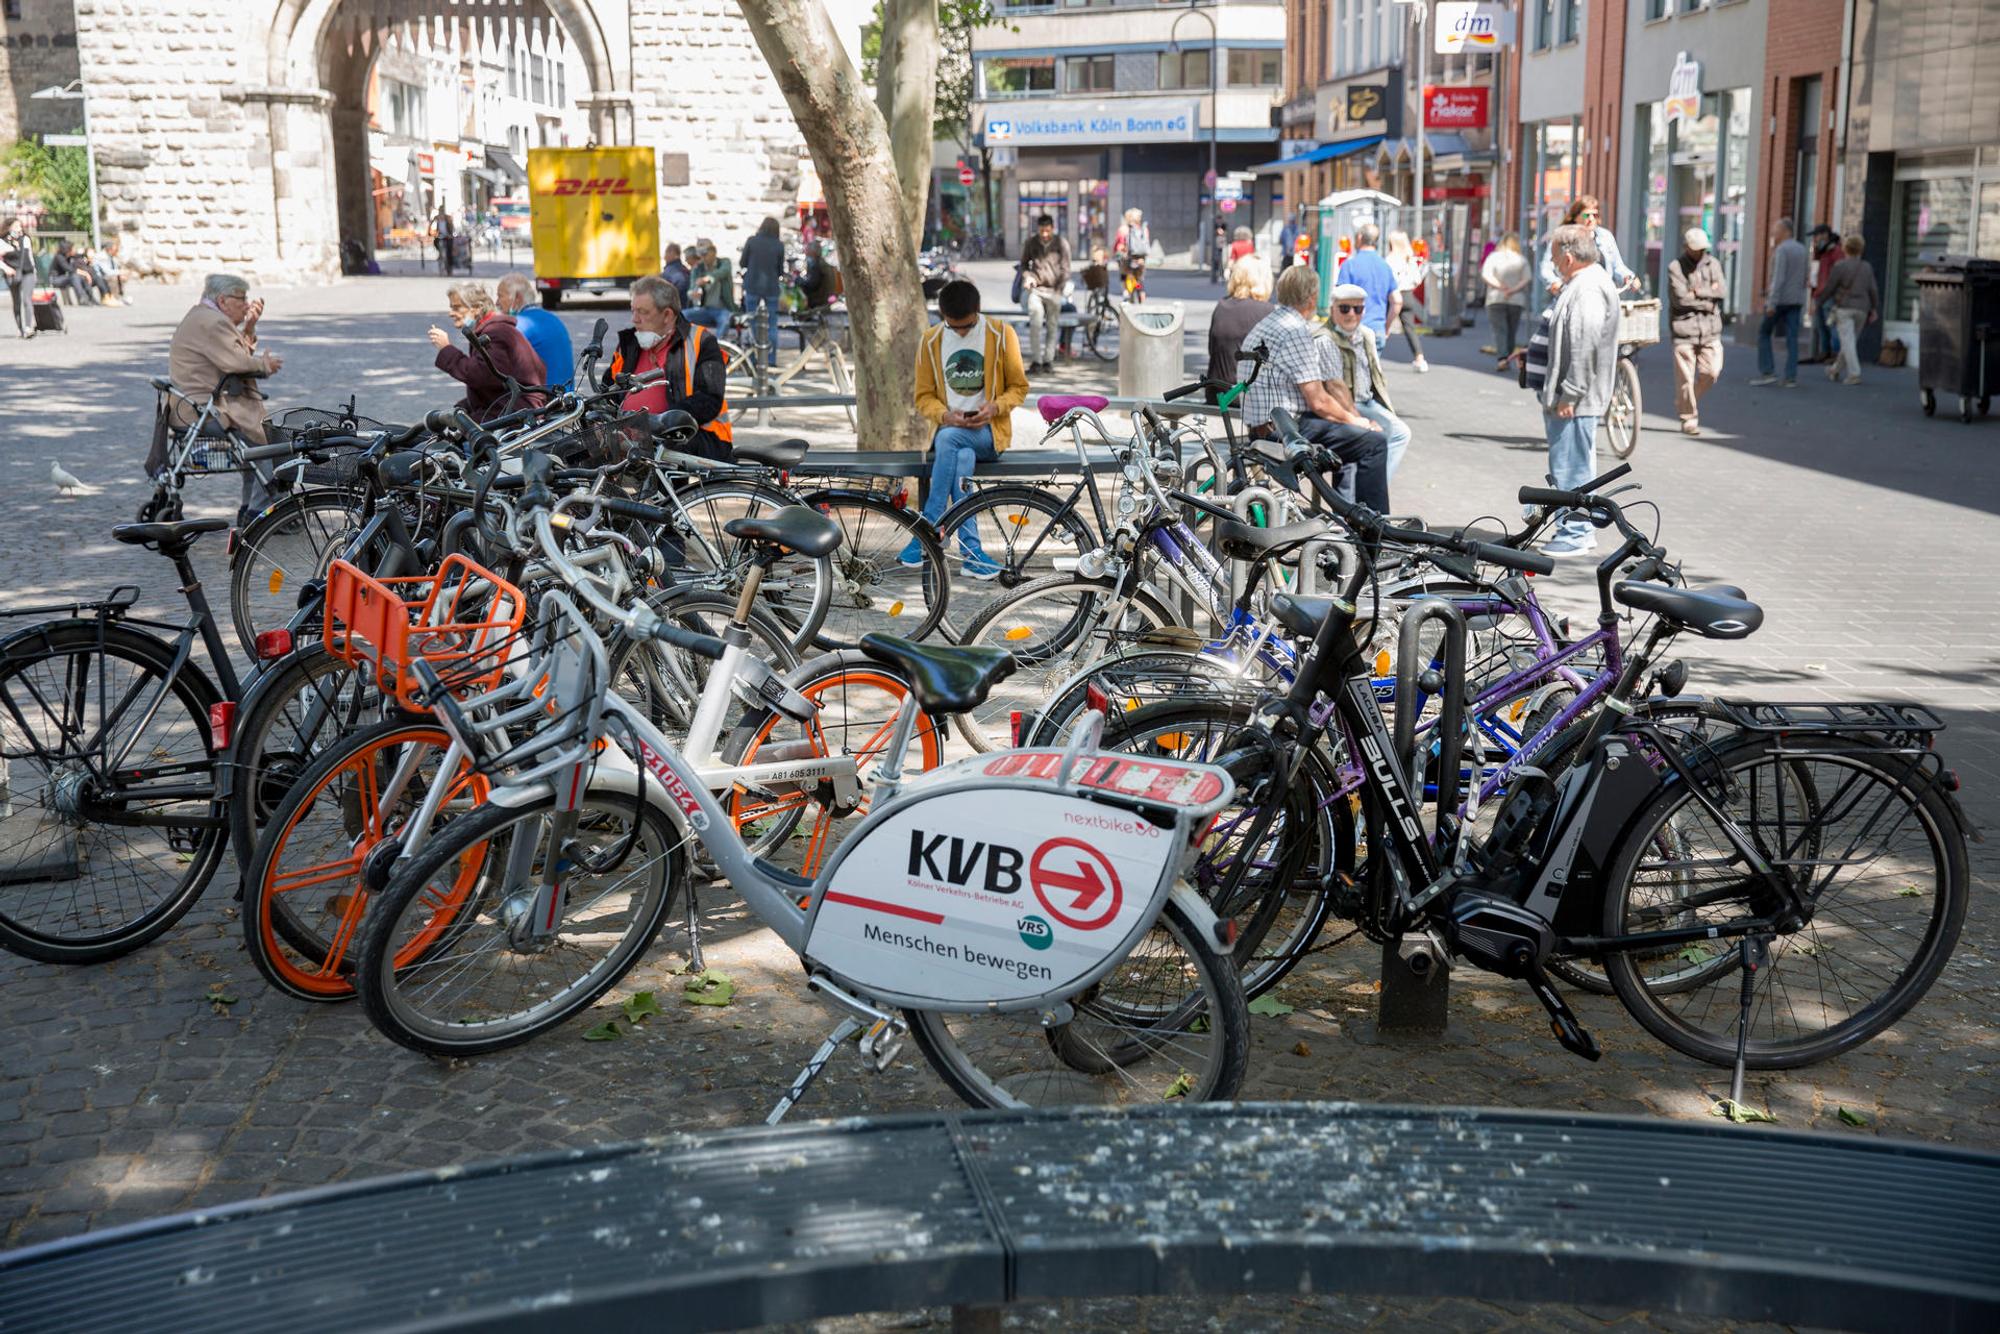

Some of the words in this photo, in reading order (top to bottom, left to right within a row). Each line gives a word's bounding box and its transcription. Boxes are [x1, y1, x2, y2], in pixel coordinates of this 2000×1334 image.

[1455, 11, 1490, 32] dm
[1016, 119, 1085, 135] Volksbank
[1090, 117, 1122, 134] Köln
[1127, 116, 1163, 132] Bonn
[1167, 115, 1187, 131] eG
[553, 178, 634, 196] DHL
[944, 361, 984, 381] Cancu
[1356, 683, 1383, 734] LACUBA
[643, 748, 695, 808] 21054
[772, 771, 787, 780] A81
[790, 769, 805, 779] 605
[806, 767, 826, 776] 3111
[1359, 734, 1420, 842] BULLS
[1064, 812, 1133, 834] nextbike
[907, 828, 1024, 894] KVB
[1011, 900, 1024, 910] AG
[1016, 919, 1045, 935] VRS
[864, 923, 958, 959] Menschen
[963, 944, 1052, 980] bewegen
